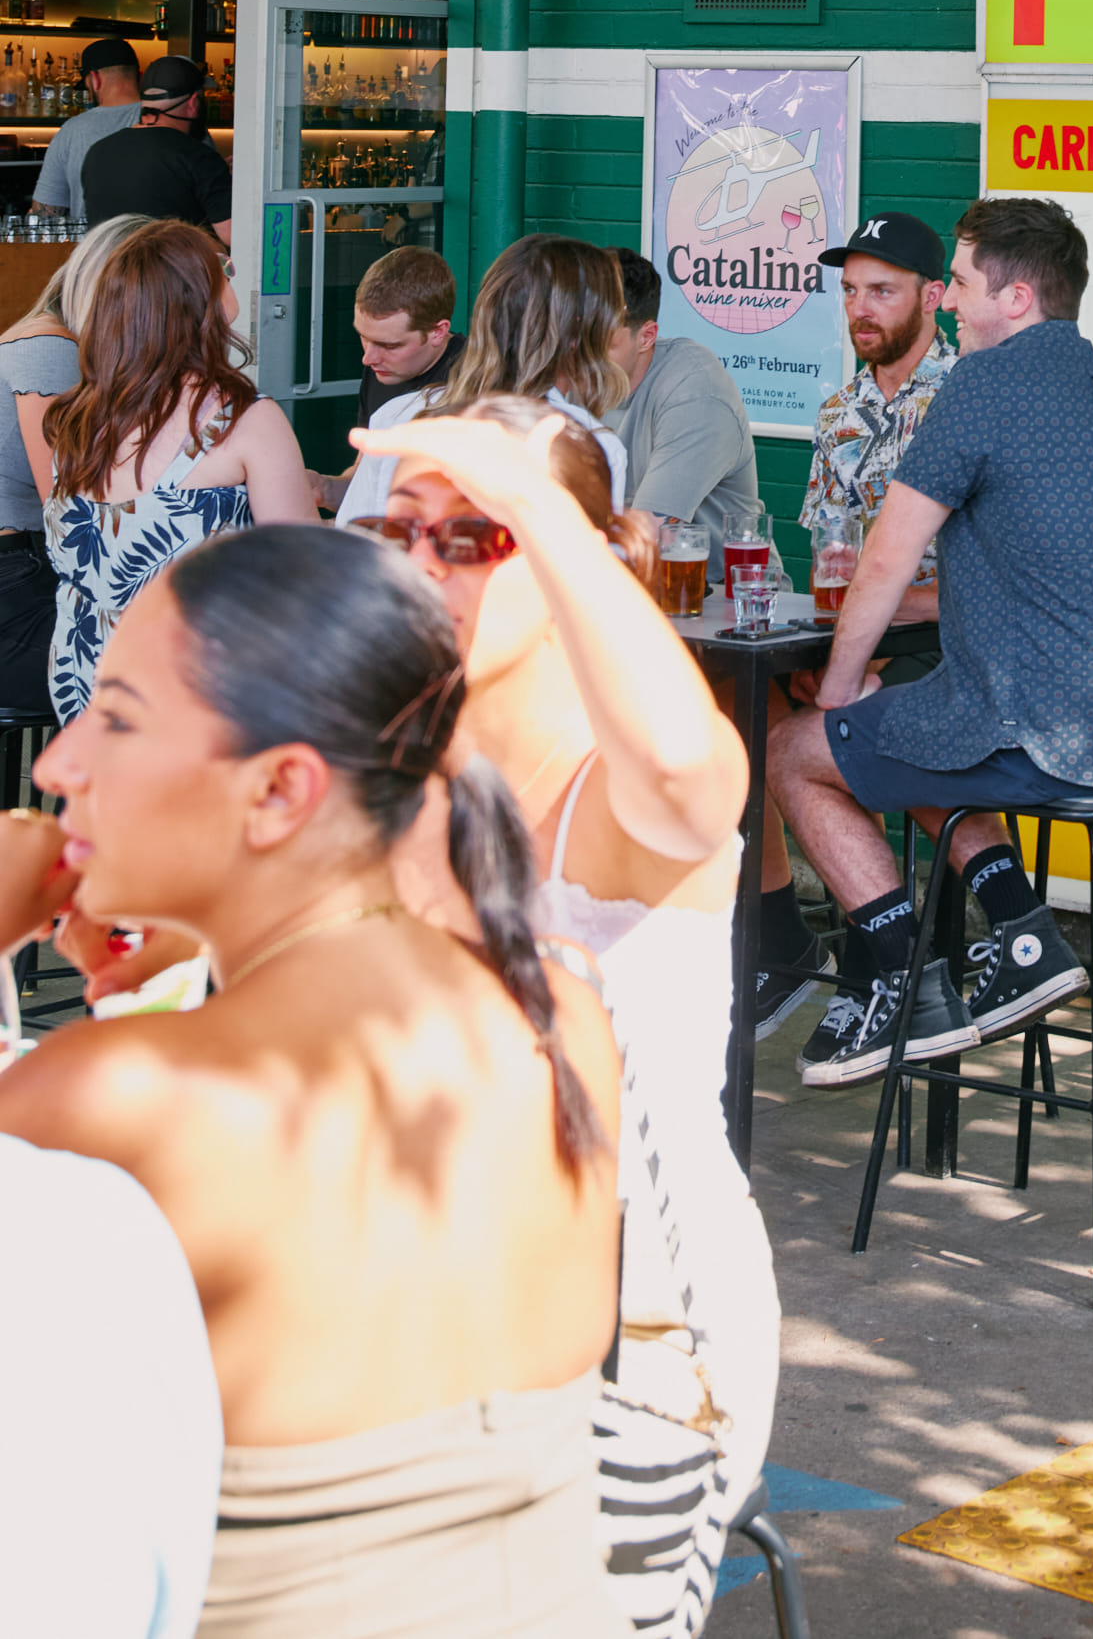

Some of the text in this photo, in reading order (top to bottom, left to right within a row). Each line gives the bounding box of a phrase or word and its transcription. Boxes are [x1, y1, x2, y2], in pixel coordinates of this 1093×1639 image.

[272, 211, 284, 287] PULL
[667, 243, 827, 294] Catalina
[696, 290, 792, 310] wine mixer
[732, 354, 756, 369] 26th
[758, 356, 822, 378] February
[742, 387, 797, 399] SALE NOW AT
[971, 857, 1014, 894] VANS
[860, 900, 913, 933] VANS
